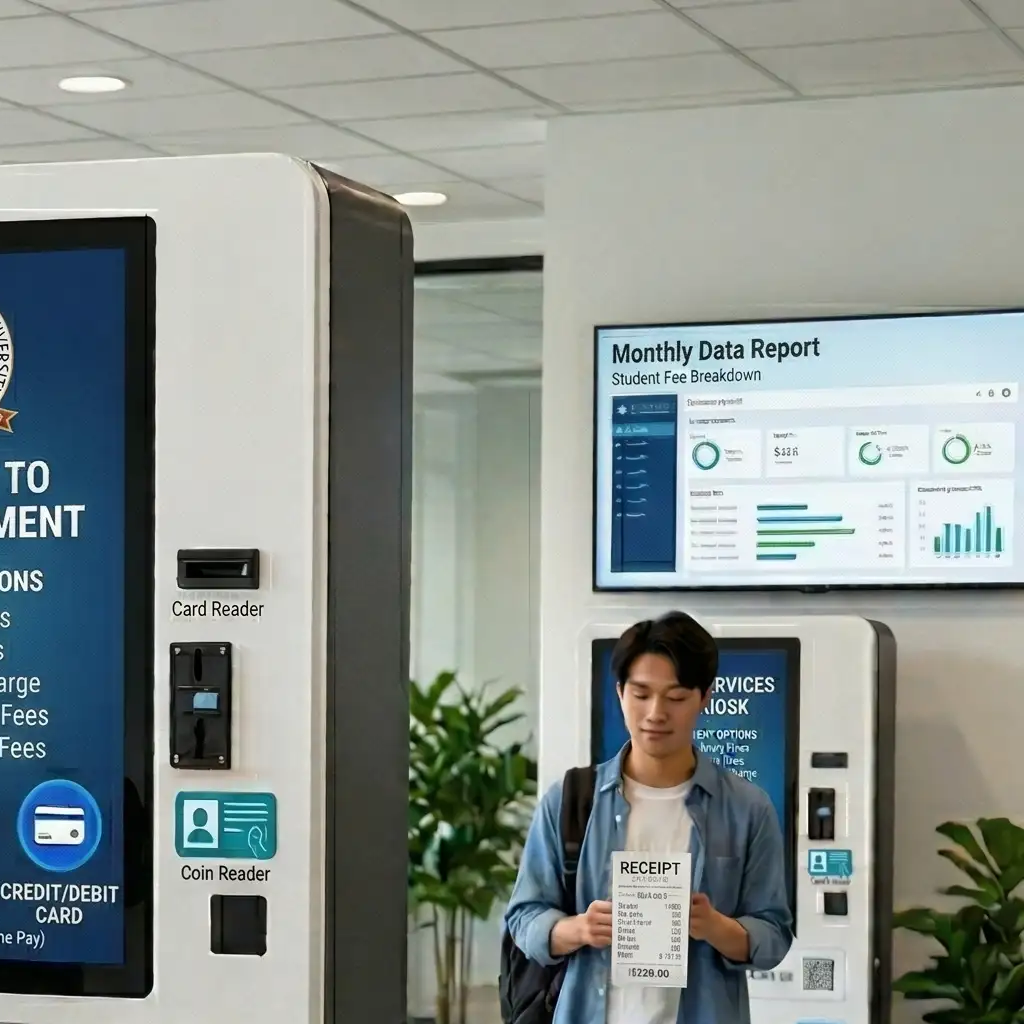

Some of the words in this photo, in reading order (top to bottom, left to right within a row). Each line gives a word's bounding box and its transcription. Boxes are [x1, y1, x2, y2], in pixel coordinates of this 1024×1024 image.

[613, 341, 693, 366] Monthly
[699, 341, 744, 360] Data
[752, 338, 820, 362] Report
[612, 371, 660, 385] Student
[665, 371, 686, 384] Fee
[691, 368, 760, 383] Breakdown
[5, 461, 49, 493] TO
[173, 601, 206, 616] Card
[212, 600, 264, 616] Reader
[711, 677, 775, 693] RVICES
[2, 704, 48, 725] Fees
[0, 737, 46, 758] Fees
[182, 865, 213, 880] Coin
[219, 866, 270, 881] Reader
[621, 862, 680, 875] RECEIPT
[1, 883, 119, 903] CREDIT/DEBIT
[36, 906, 82, 924] CARD
[17, 930, 44, 949] Pay)
